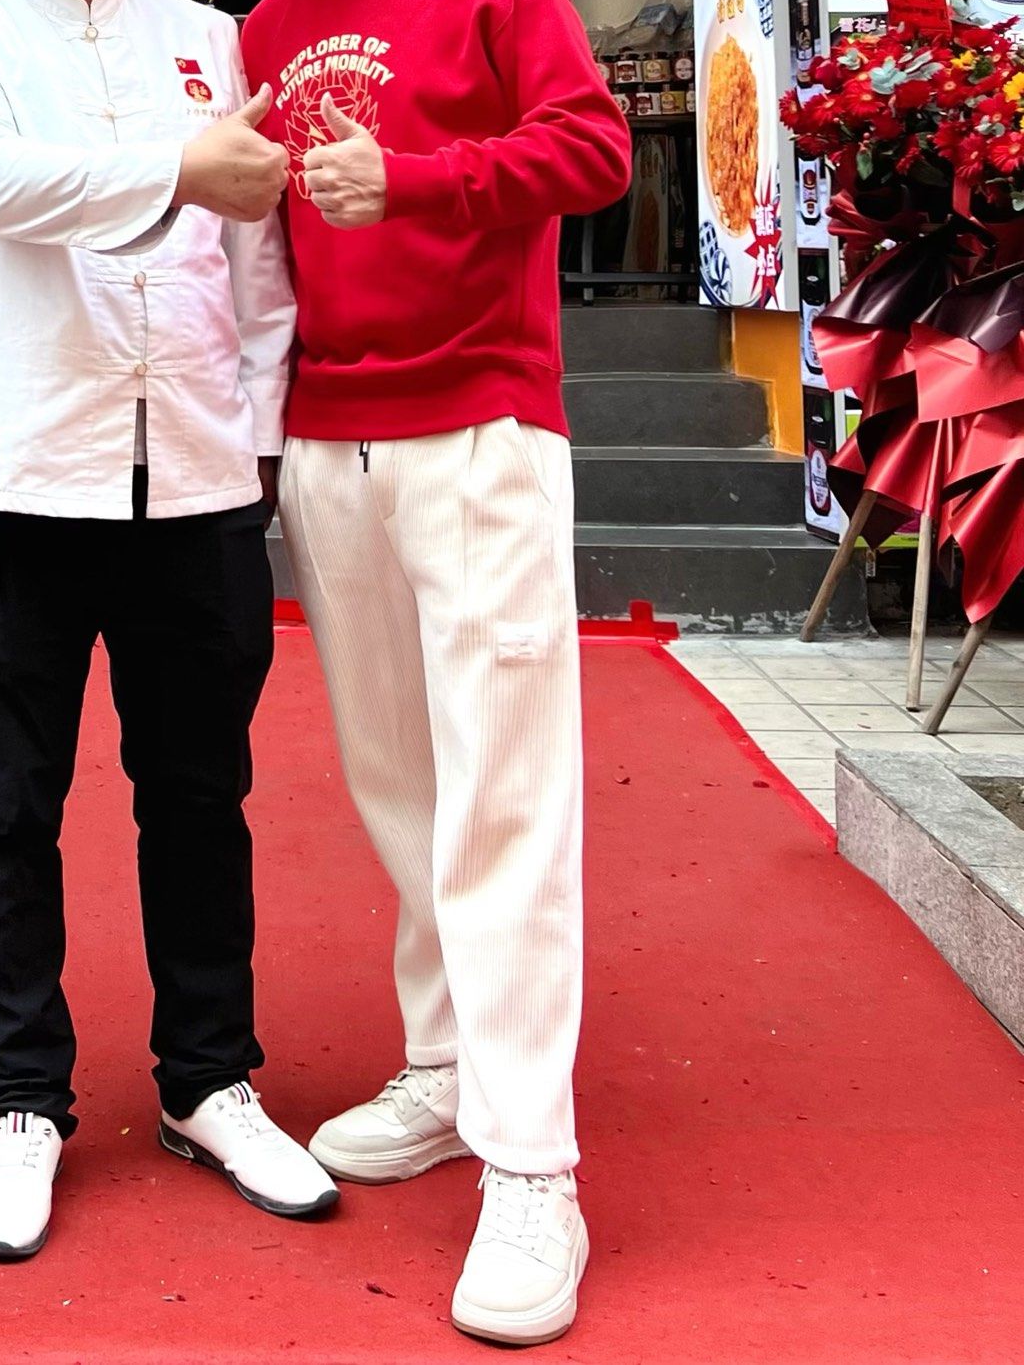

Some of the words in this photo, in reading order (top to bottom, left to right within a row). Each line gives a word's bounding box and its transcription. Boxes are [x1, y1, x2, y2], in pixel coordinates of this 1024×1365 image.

[275, 62, 322, 110] FUTURE
[324, 53, 395, 86] MOBILITY
[279, 34, 362, 85] EXPLORER
[362, 36, 391, 56] OF
